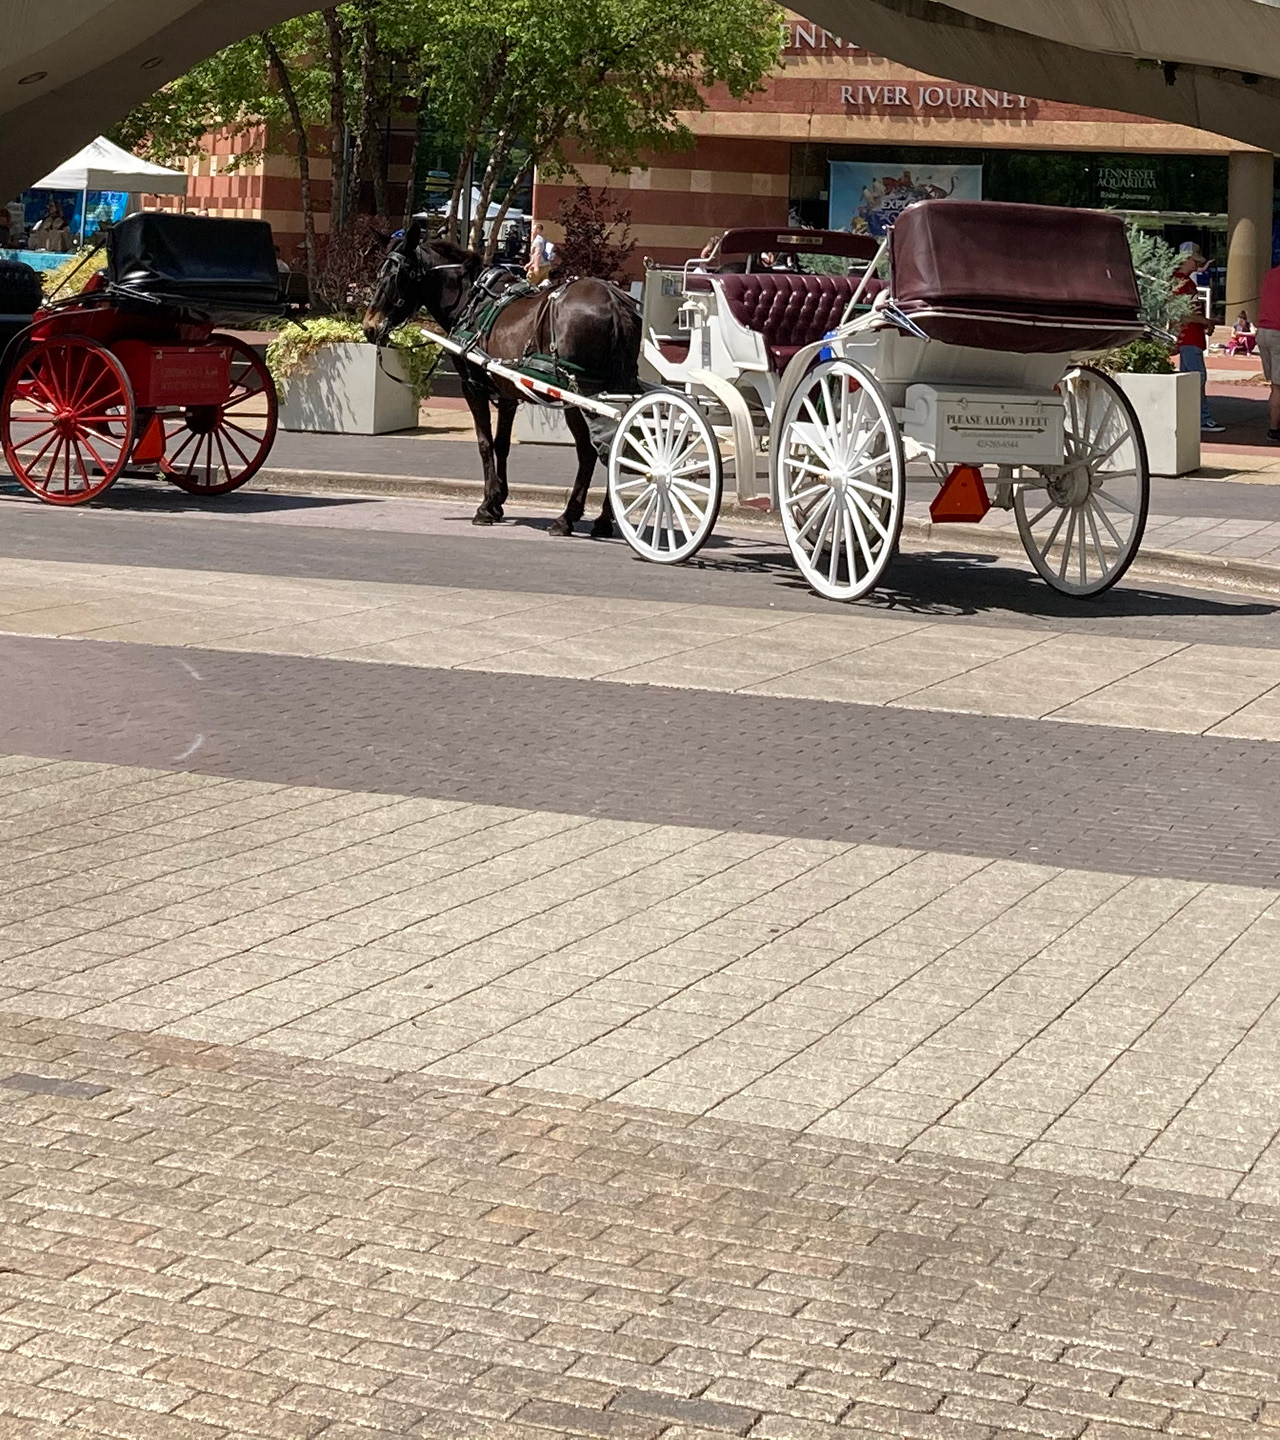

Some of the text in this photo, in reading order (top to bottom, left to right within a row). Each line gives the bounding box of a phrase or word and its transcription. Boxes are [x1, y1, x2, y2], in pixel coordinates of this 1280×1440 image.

[840, 85, 1028, 109] RIVER JOURNEY
[1097, 168, 1156, 179] TENNESSEE
[1097, 178, 1157, 190] AQUARIUM
[946, 414, 1049, 427] PLEASE ALLOW 3 FEET
